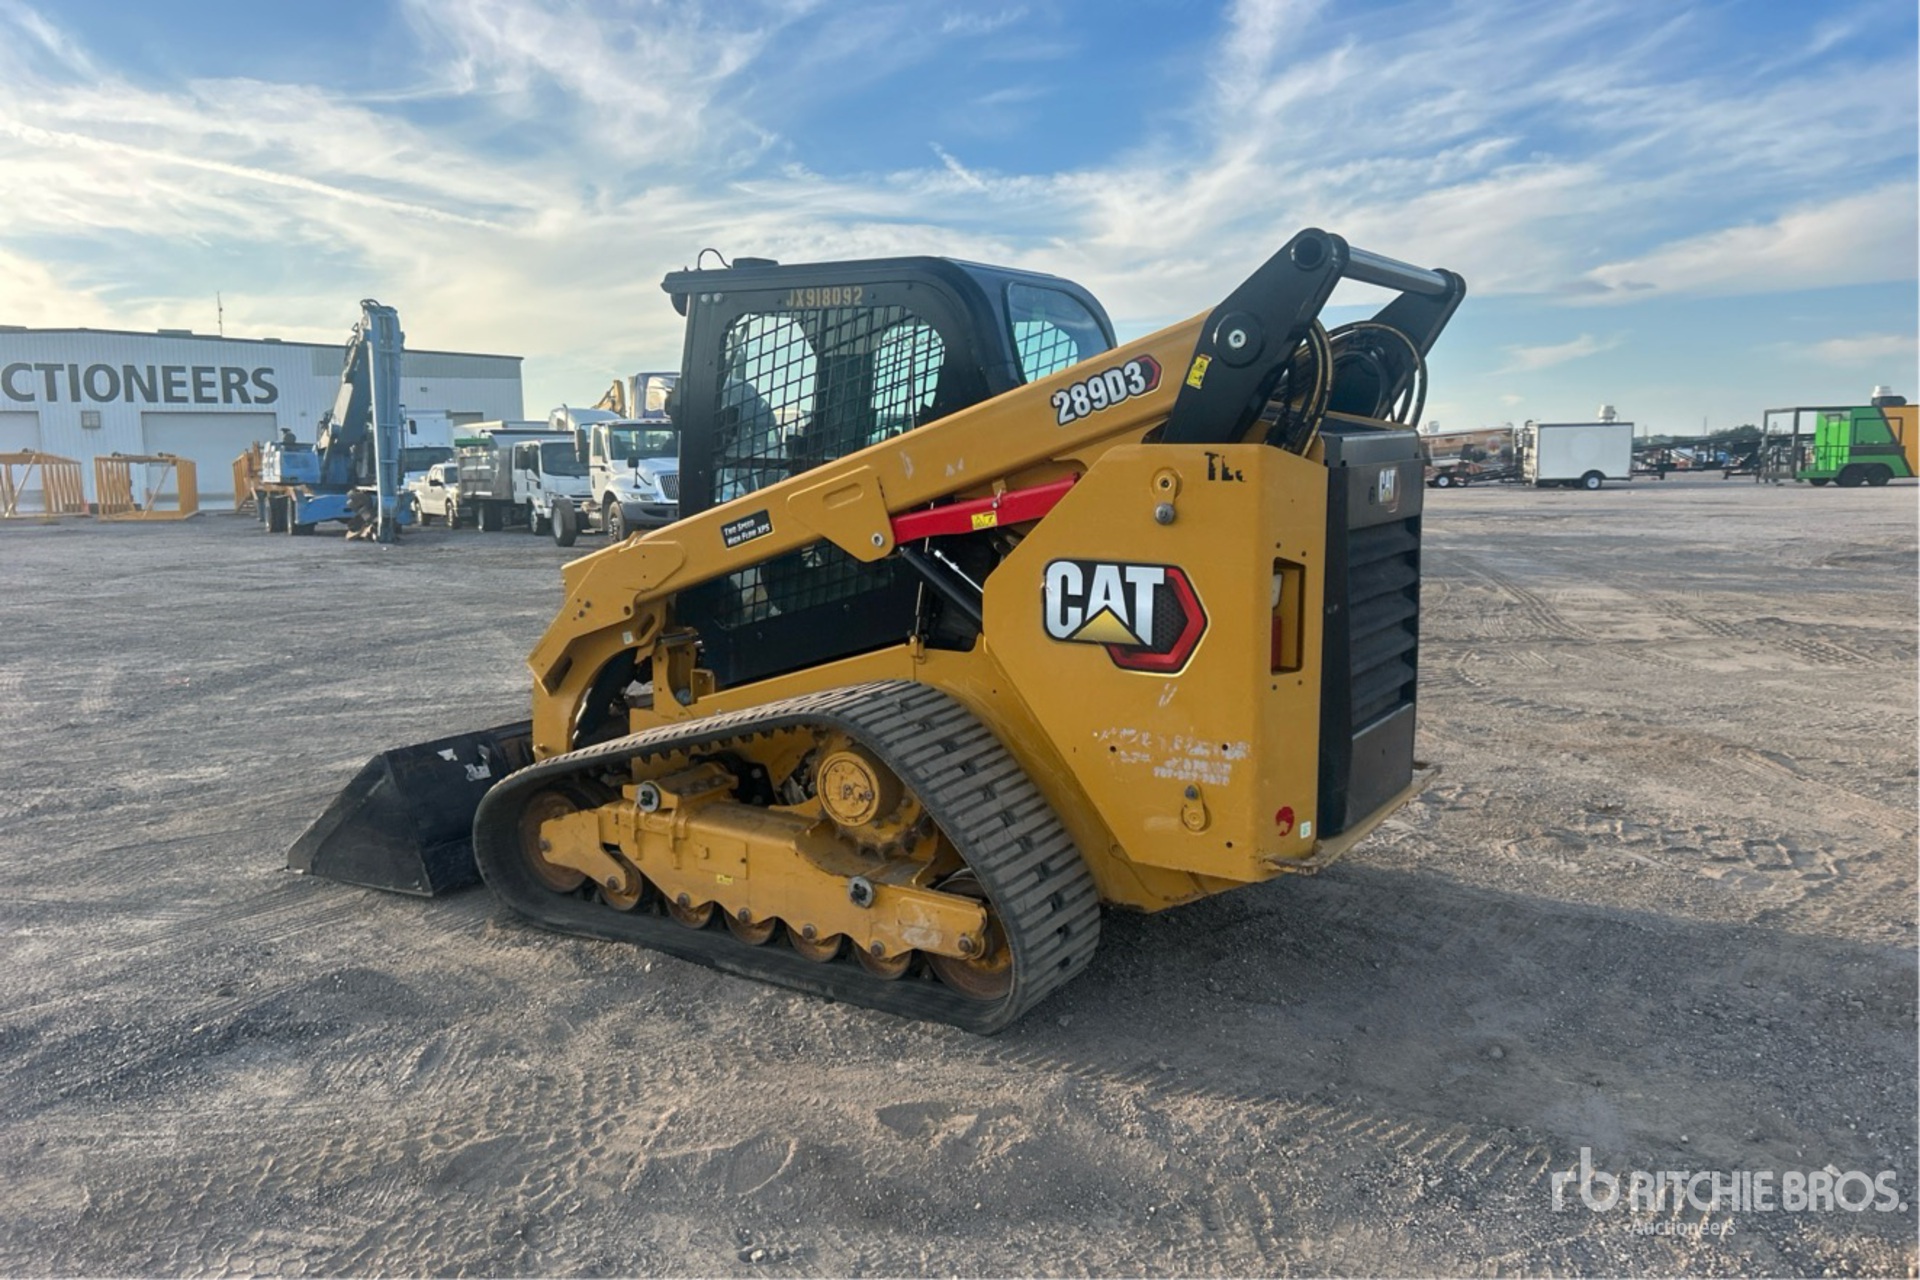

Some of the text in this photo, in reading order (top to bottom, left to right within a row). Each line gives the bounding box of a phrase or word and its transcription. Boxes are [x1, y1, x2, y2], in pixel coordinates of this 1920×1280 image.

[786, 286, 863, 307] JX918092
[1, 362, 279, 404] CTIONEERS
[1053, 361, 1146, 425] 289D3
[1046, 561, 1164, 646] CAT
